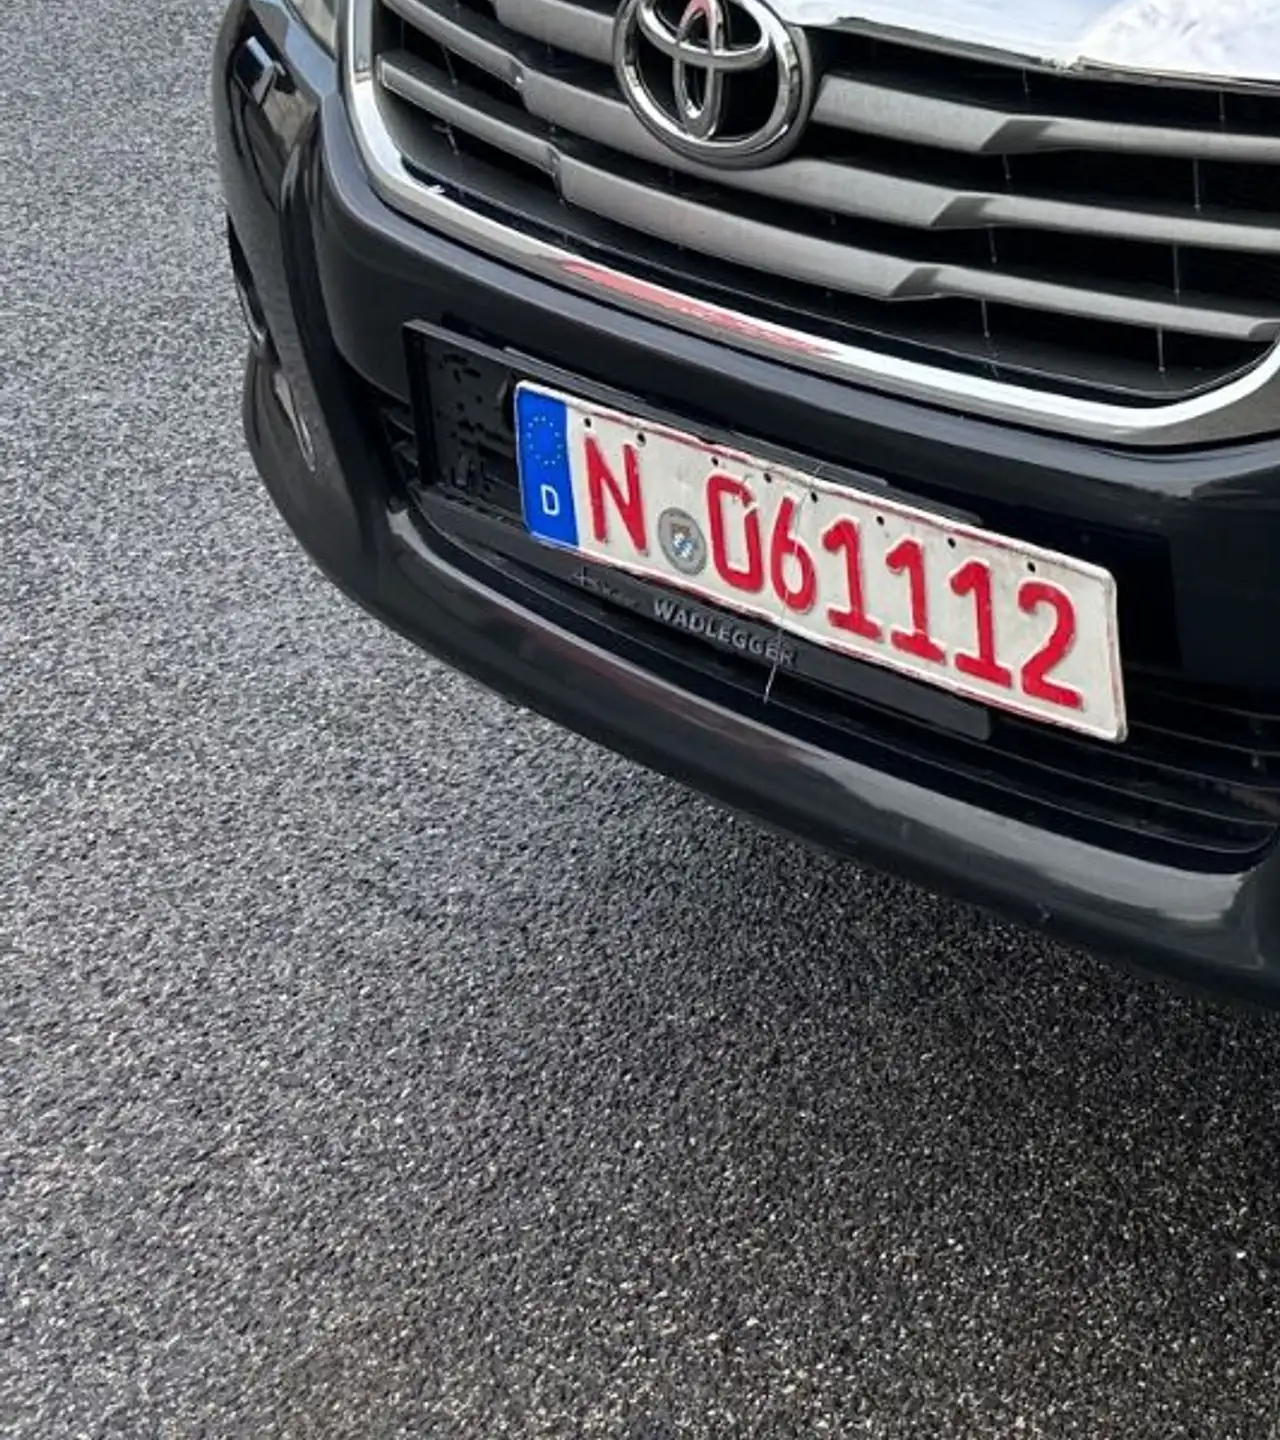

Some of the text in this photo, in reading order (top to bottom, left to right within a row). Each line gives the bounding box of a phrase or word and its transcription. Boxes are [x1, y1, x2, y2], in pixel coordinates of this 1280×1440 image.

[540, 484, 560, 516] D
[585, 436, 1084, 710] N 061112
[653, 599, 797, 667] WADLEGGER
